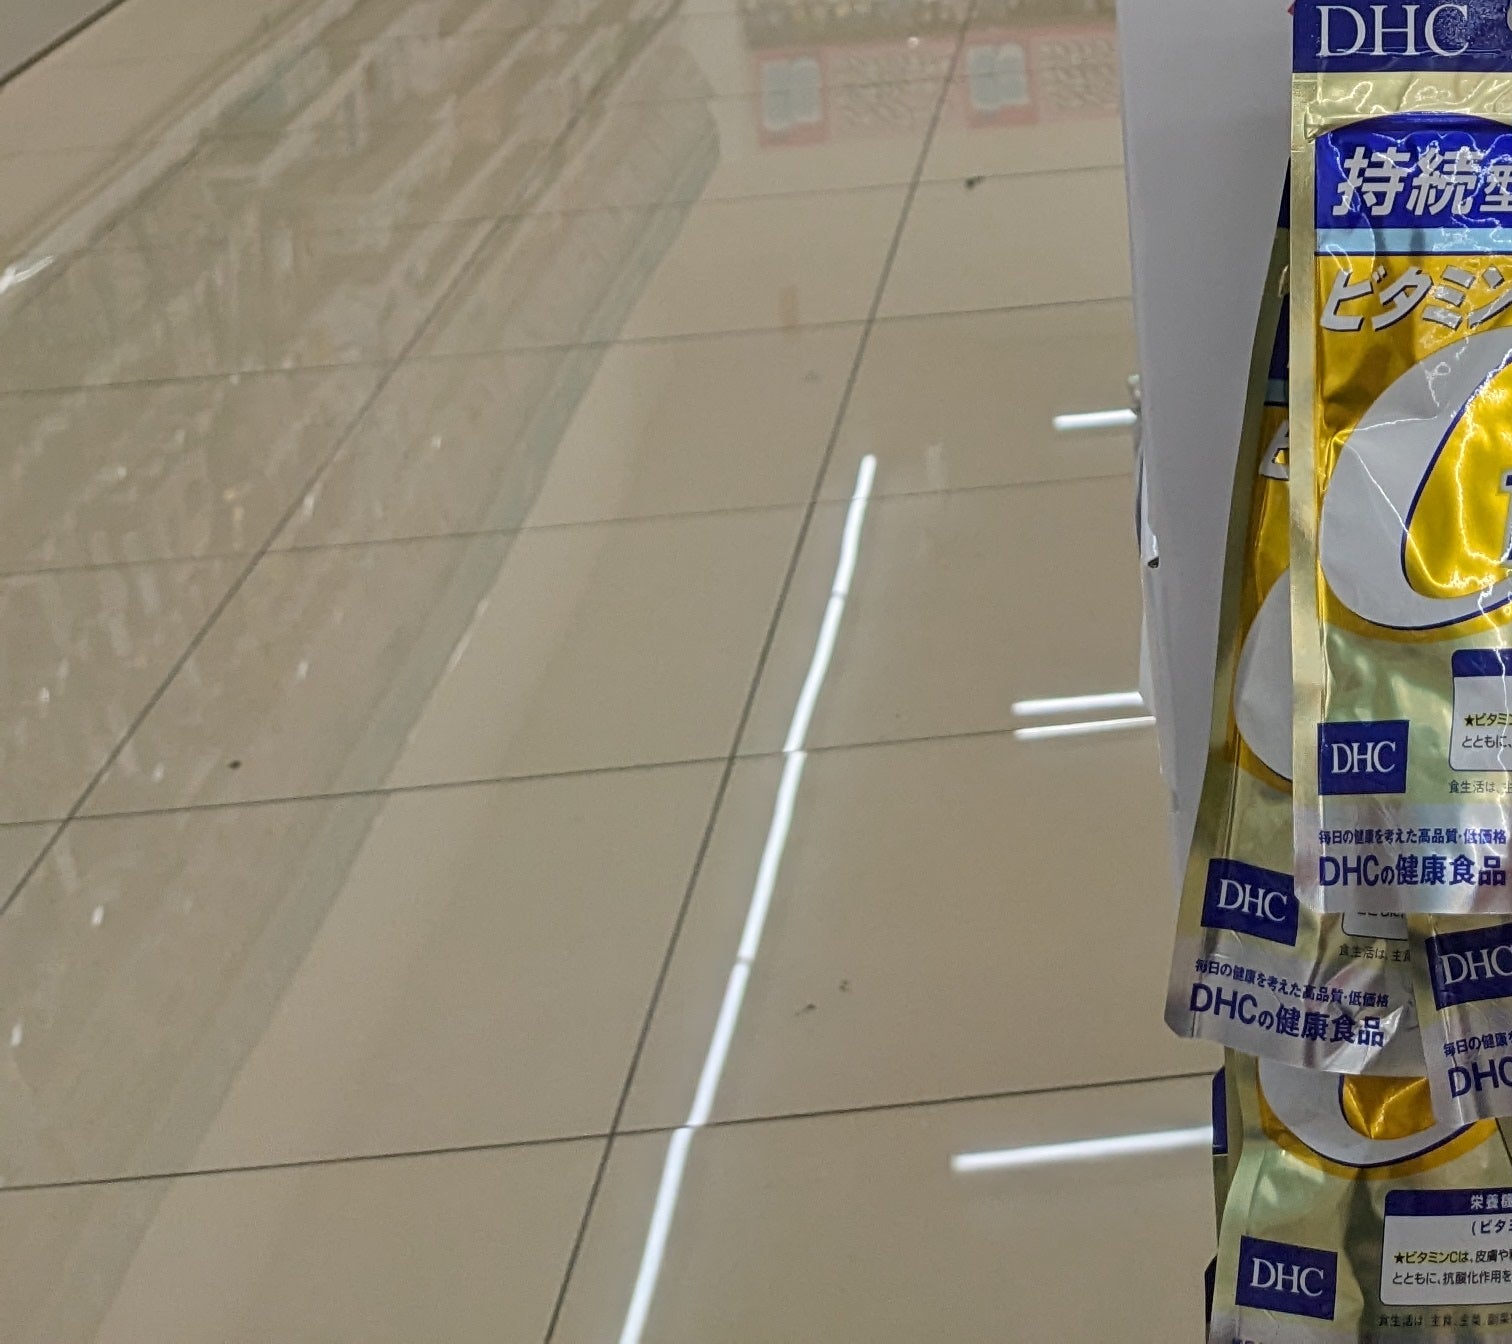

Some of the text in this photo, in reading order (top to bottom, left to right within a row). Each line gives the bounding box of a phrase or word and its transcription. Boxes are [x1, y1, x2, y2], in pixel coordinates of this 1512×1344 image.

[1316, 4, 1468, 56] DHC
[1330, 741, 1397, 774] DHC
[1318, 854, 1507, 887] DHCの健康食品
[1217, 879, 1287, 922] DHC
[1189, 983, 1383, 1047] DHCの健康食品
[1249, 1258, 1324, 1297] DHC
